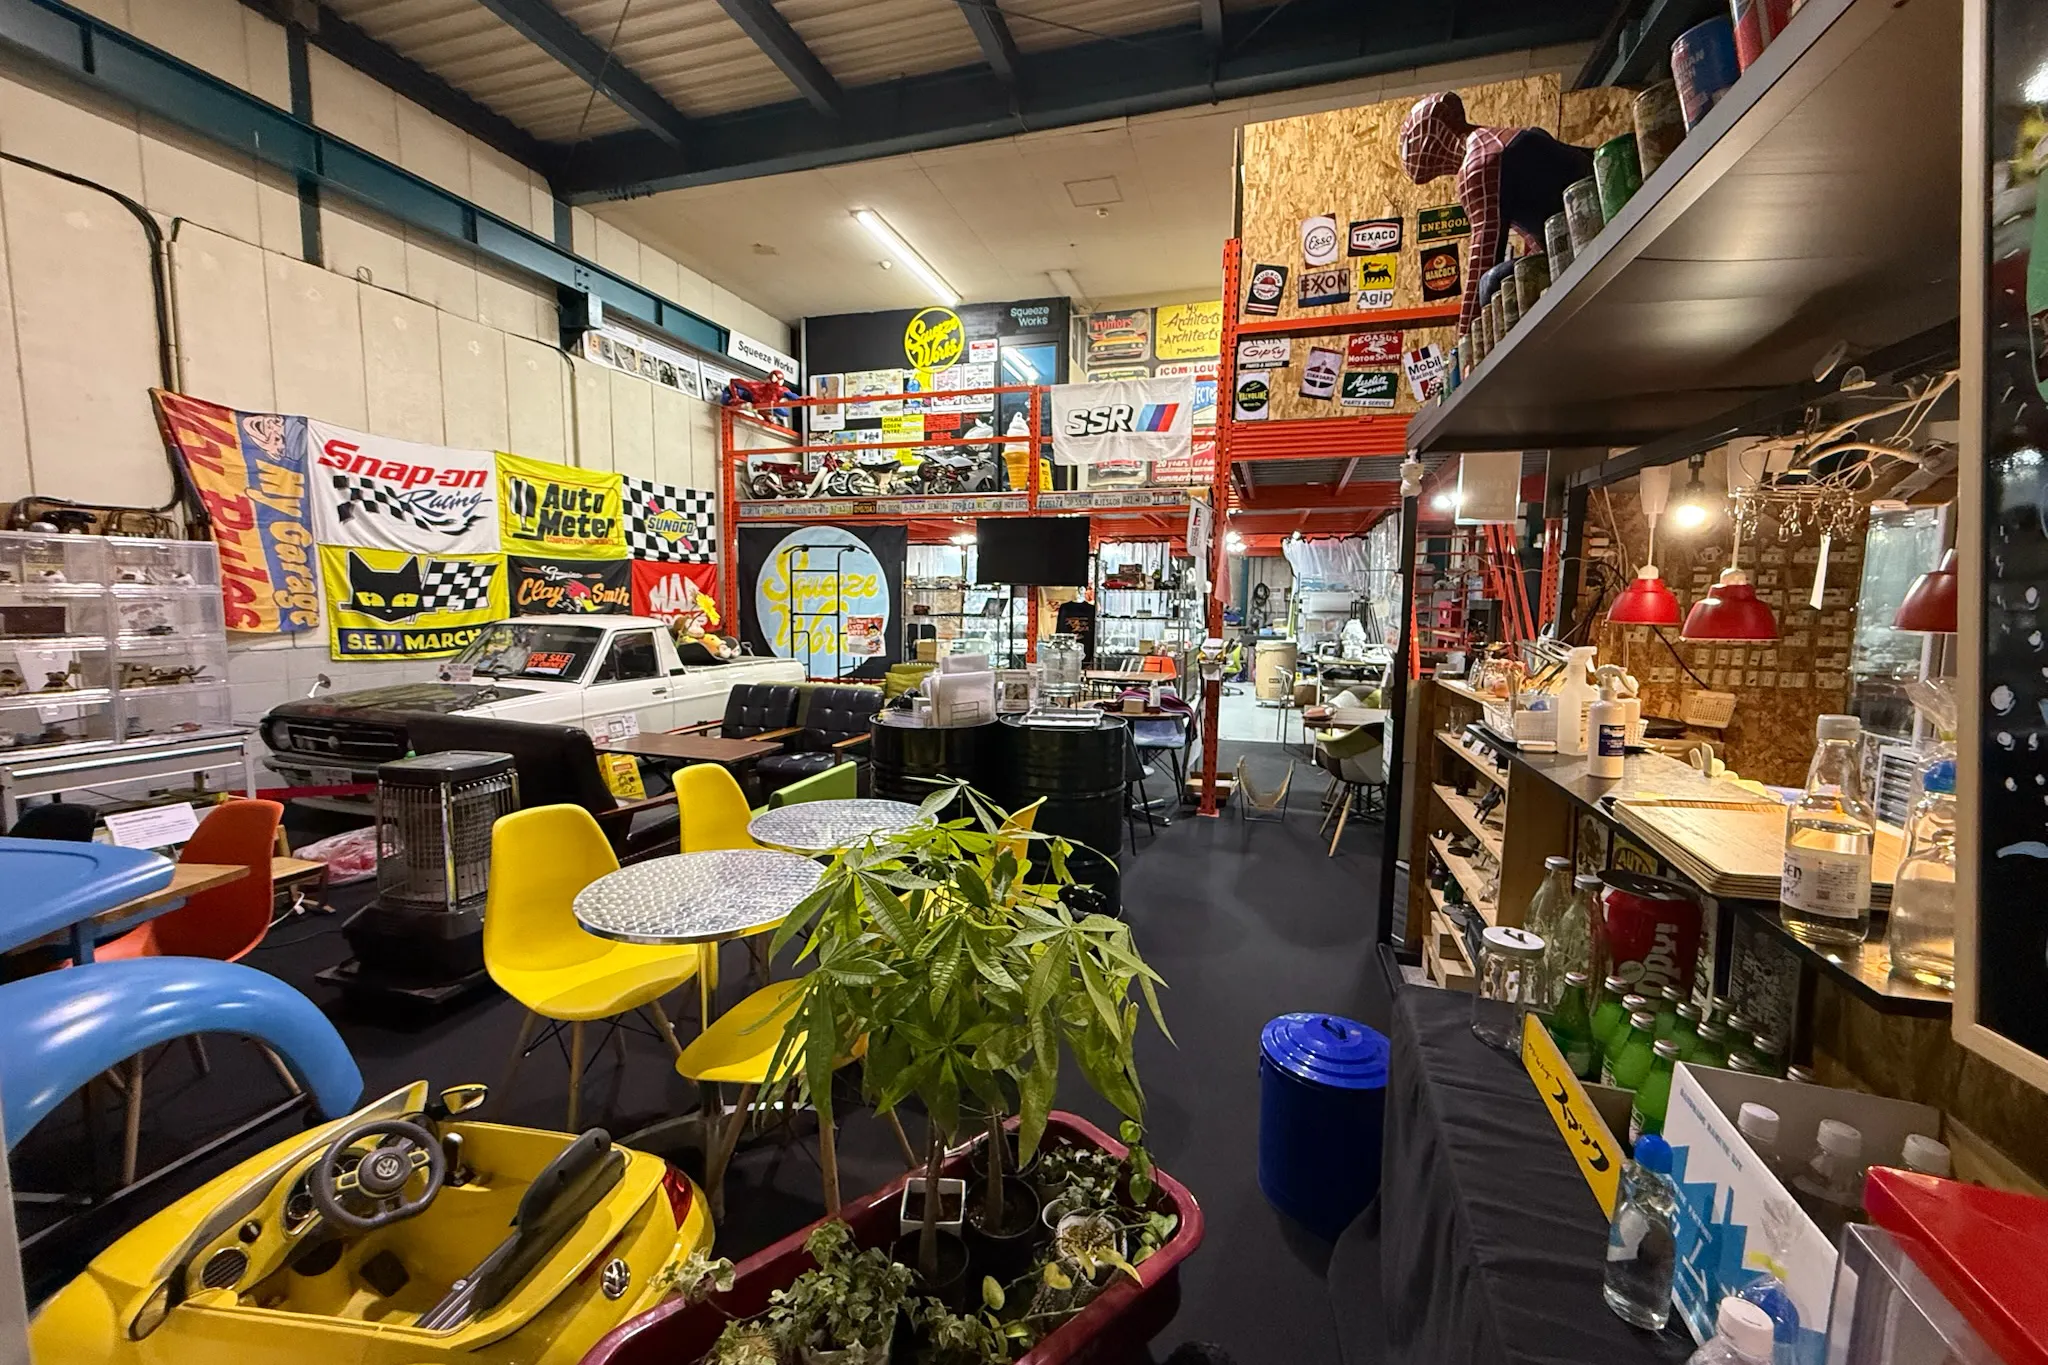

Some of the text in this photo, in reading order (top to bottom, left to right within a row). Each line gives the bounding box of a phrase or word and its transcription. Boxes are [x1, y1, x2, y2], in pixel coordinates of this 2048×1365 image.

[1421, 217, 1469, 233] ENERGOL
[1308, 235, 1332, 251] Esso
[1355, 230, 1396, 242] TEXACO
[1425, 266, 1457, 281] HANCOCK
[1300, 272, 1348, 296] EXXON
[1357, 291, 1393, 305] Agip
[1010, 306, 1050, 317] Squeeze
[1018, 316, 1048, 327] Works
[1351, 333, 1399, 348] PEGASUS
[738, 340, 794, 375] Squeeze Works
[1243, 345, 1286, 360] Gipsy
[1407, 355, 1442, 376] Mobil
[1347, 373, 1390, 392] Austin
[1411, 370, 1435, 383] Racing
[1355, 385, 1388, 398] Seven
[1065, 403, 1135, 437] SSR
[317, 439, 488, 490] Snap-on
[245, 459, 305, 518] My
[397, 490, 493, 518] Racing
[541, 483, 606, 514] Auto
[537, 509, 615, 541] Meter
[647, 517, 695, 534] SUNOCO
[268, 521, 320, 627] Garage
[762, 545, 879, 612] Squeeze
[518, 578, 630, 608] Clay Smith
[550, 654, 573, 663] SALE
